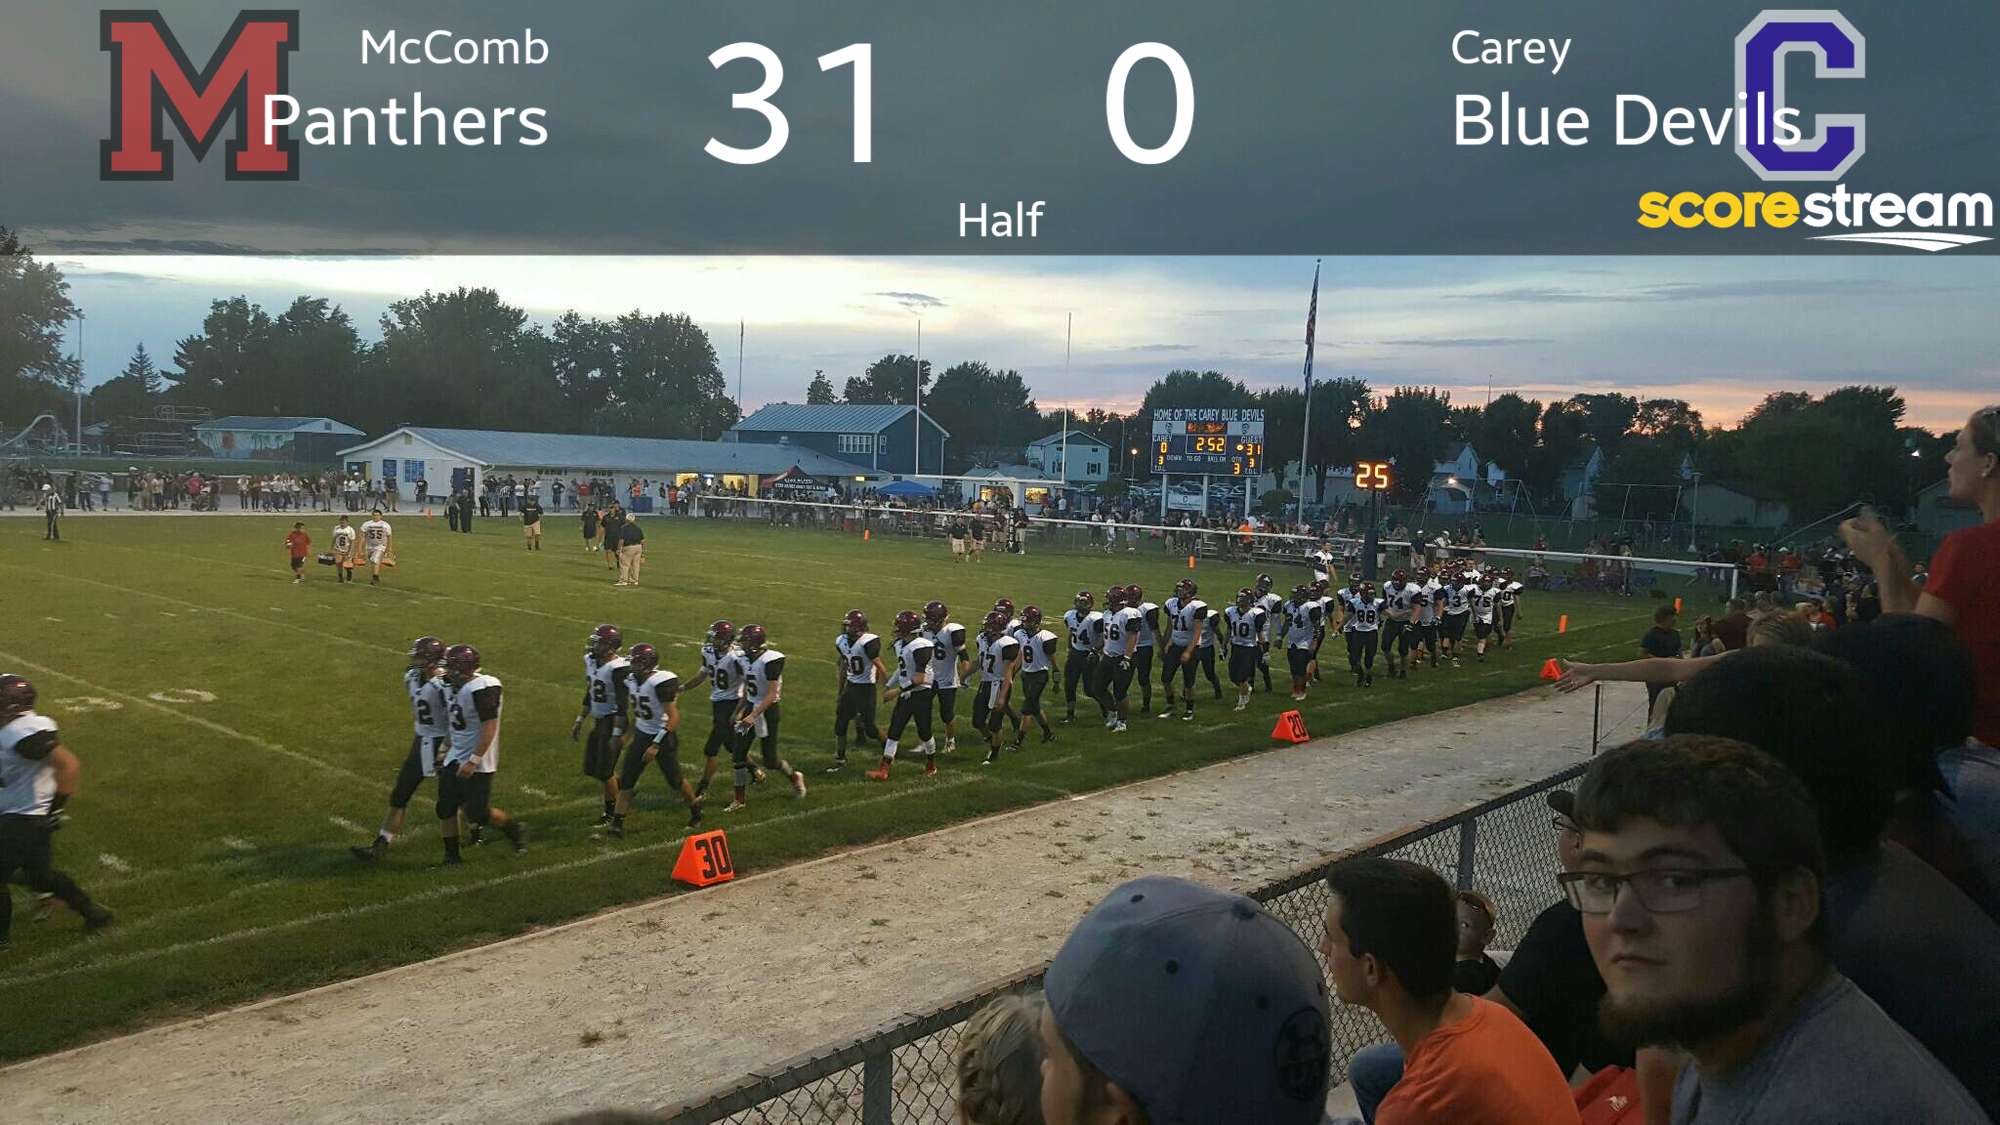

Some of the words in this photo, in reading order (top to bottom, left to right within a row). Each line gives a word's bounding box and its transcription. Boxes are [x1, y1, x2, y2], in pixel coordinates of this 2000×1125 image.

[1154, 409, 1172, 420] HOME
[1174, 409, 1182, 420] OF
[1185, 409, 1197, 420] THE
[1199, 409, 1219, 421] CAREY
[1222, 409, 1238, 421] BLUE
[1241, 409, 1265, 421] DEVILS
[1241, 435, 1262, 443] GUEST
[1160, 442, 1168, 453] 0
[1246, 444, 1261, 455] 31
[1158, 456, 1164, 465] 3
[1249, 458, 1255, 468] 3
[1233, 463, 1241, 475] 3
[1356, 463, 1388, 489] 25
[368, 529, 383, 540] 55
[1356, 609, 1376, 623] 88
[1287, 714, 1306, 739] 20
[694, 835, 732, 879] 30
